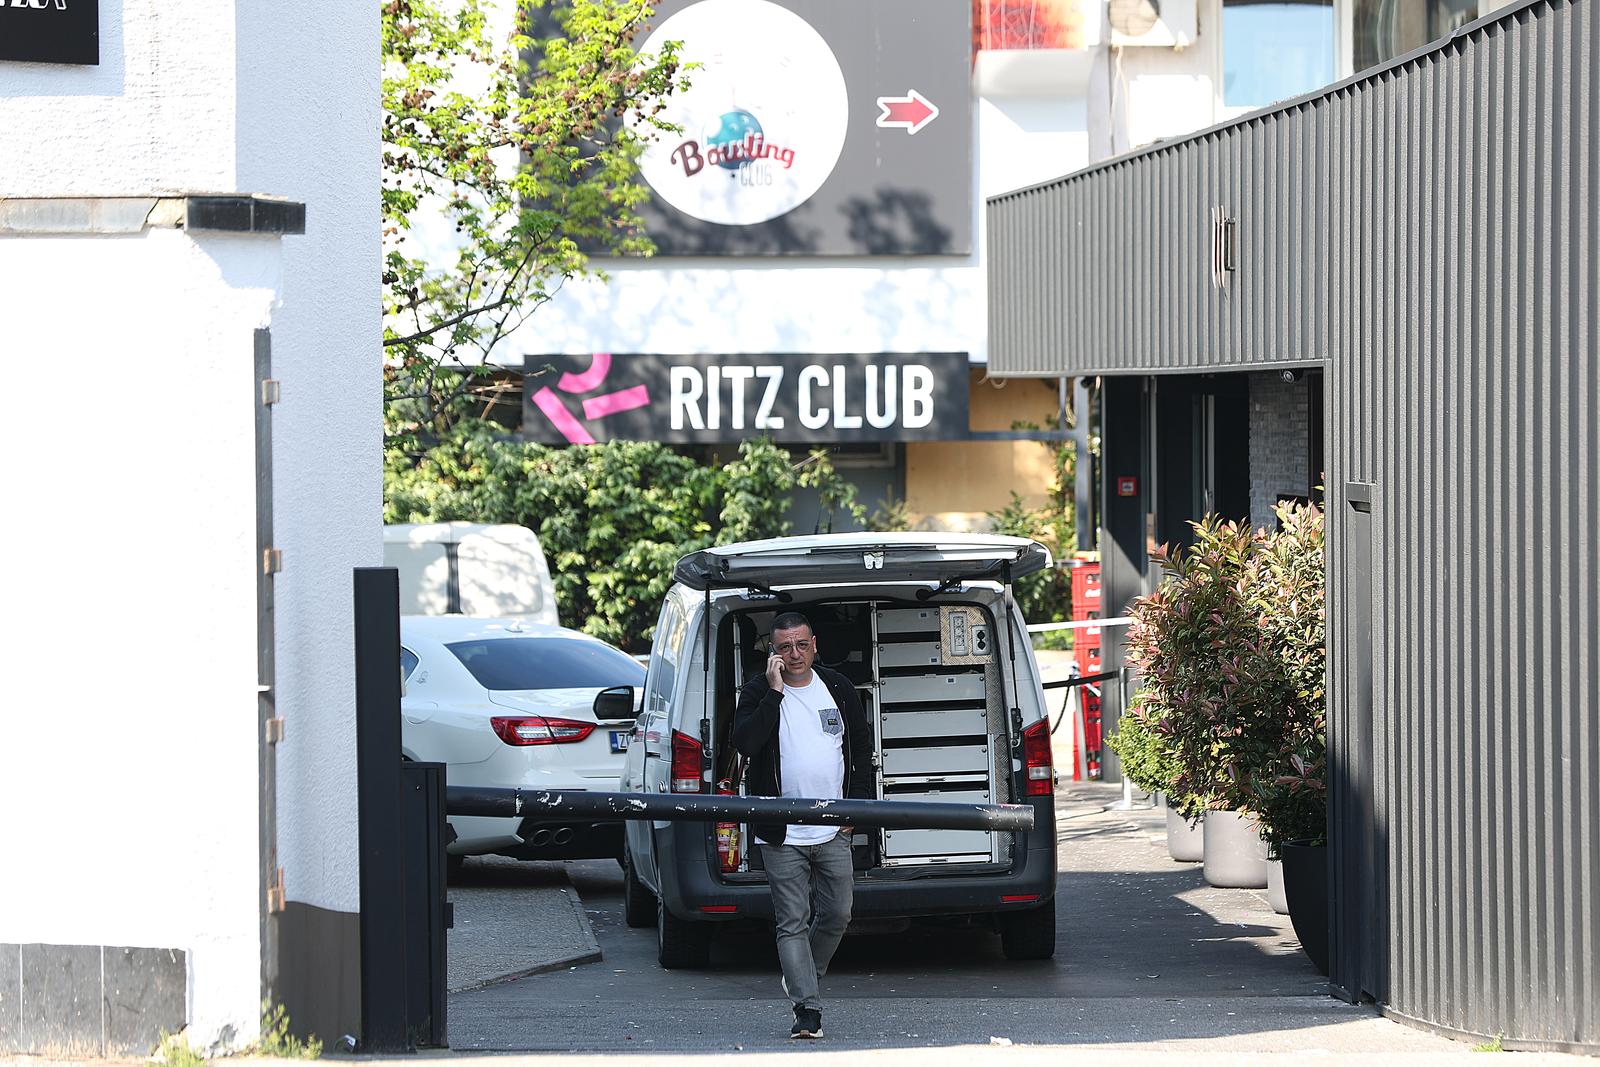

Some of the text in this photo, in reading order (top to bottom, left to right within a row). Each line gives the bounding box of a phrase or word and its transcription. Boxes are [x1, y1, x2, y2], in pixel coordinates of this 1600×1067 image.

[671, 134, 795, 177] Bowling
[670, 364, 935, 430] RITZ CLUB
